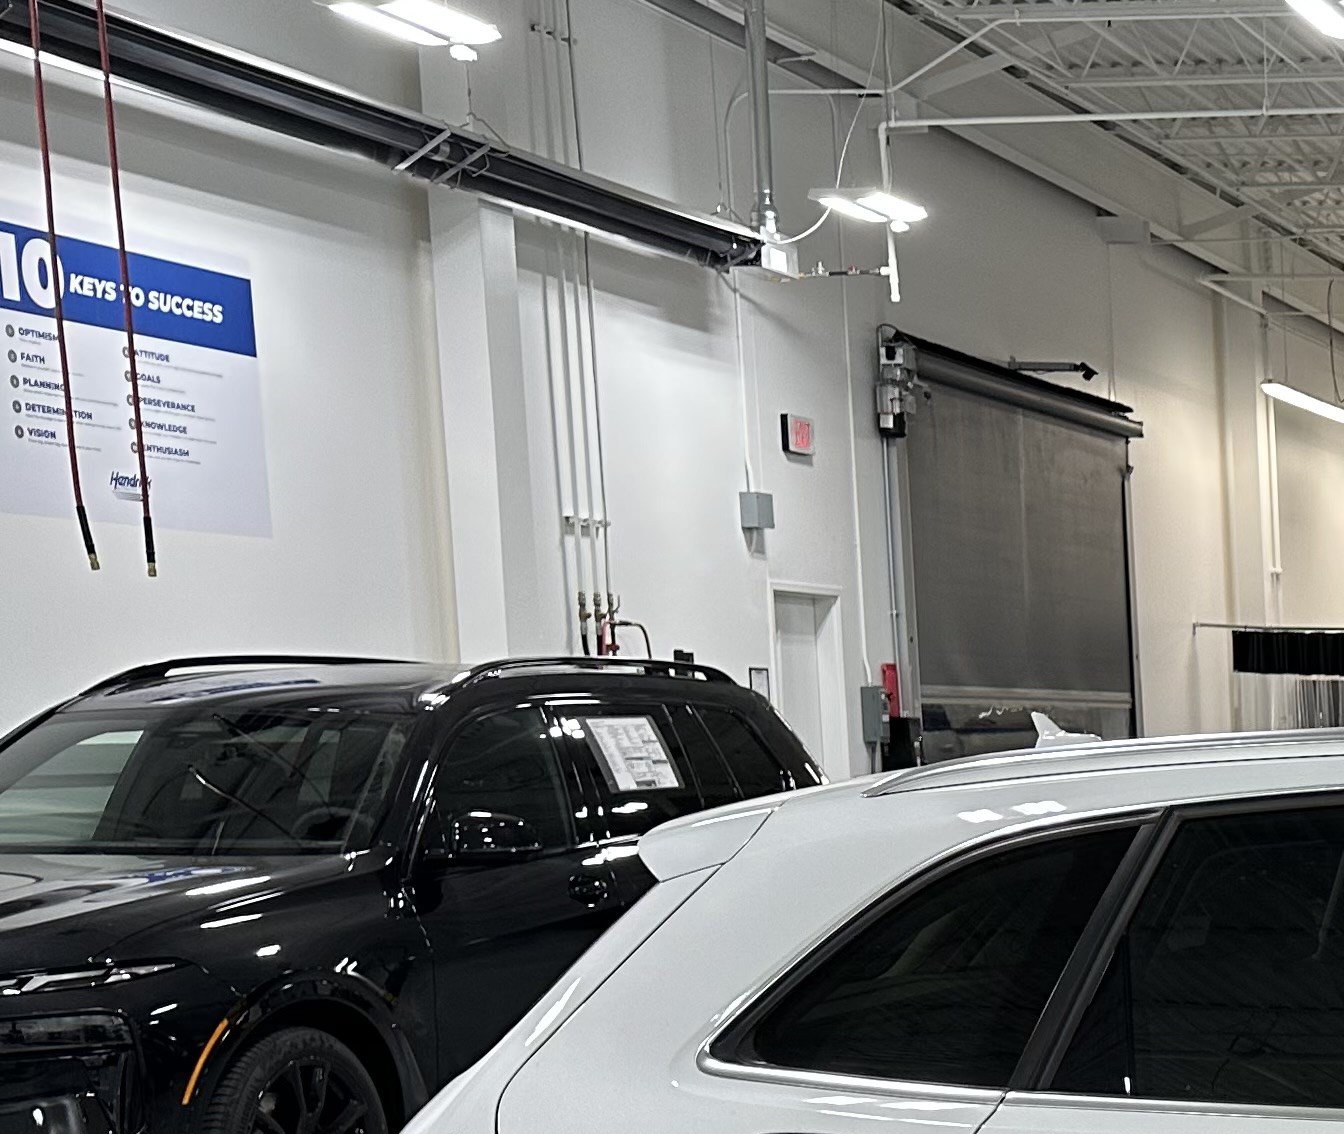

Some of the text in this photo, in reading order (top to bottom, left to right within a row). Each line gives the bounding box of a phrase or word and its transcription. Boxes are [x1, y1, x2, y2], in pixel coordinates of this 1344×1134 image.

[0, 231, 223, 324] 10 KEYS O SUCCESS
[20, 352, 46, 364] FAITH
[24, 402, 93, 420] DETERMINTION
[27, 427, 57, 440] VISION
[141, 420, 188, 435] NOWLEDGE
[143, 442, 190, 458] NTHUSIASM
